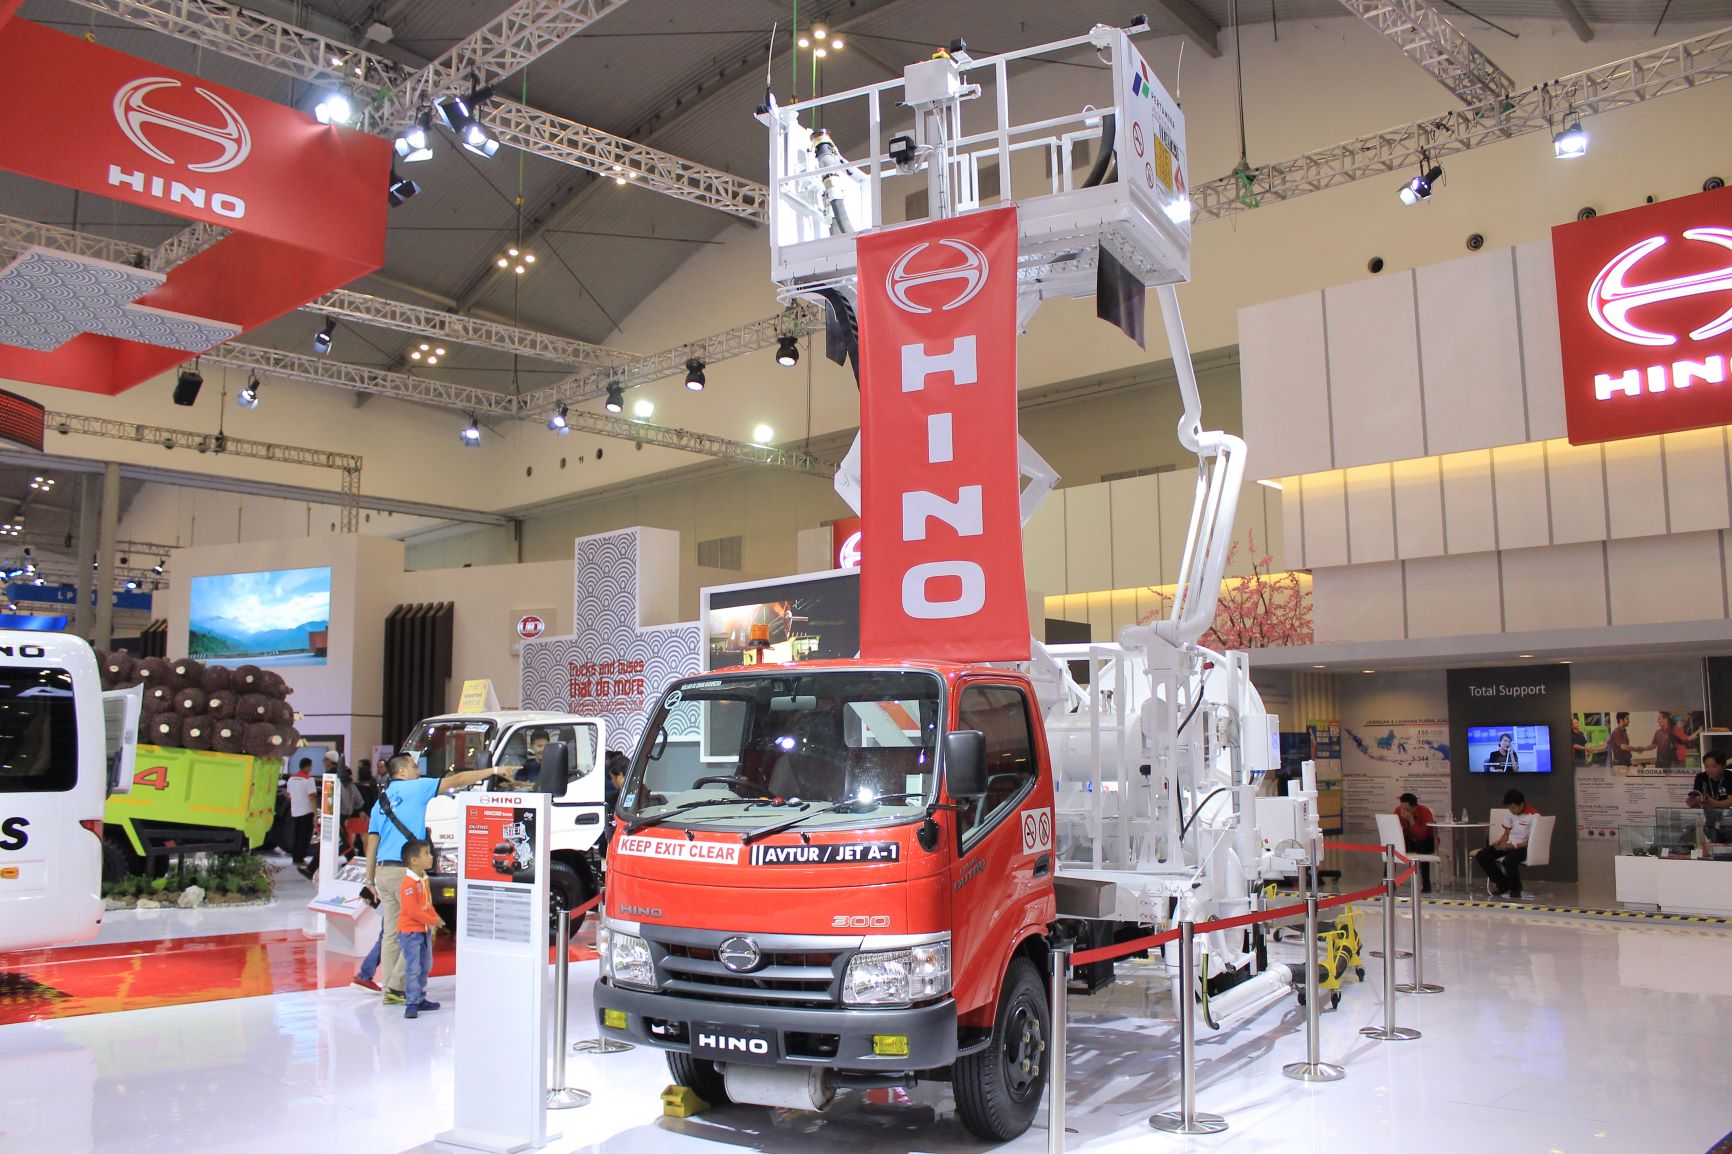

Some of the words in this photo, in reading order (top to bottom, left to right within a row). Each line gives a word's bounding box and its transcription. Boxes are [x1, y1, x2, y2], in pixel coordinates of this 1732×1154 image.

[107, 163, 246, 219] HINO
[1593, 354, 1732, 401] HIN
[901, 334, 986, 619] HINO
[568, 661, 597, 677] Trucks
[598, 657, 615, 676] and
[618, 658, 645, 675] buses
[569, 677, 593, 698] that
[595, 676, 610, 697] do
[613, 678, 645, 696] more
[1469, 685, 1496, 697] Total
[1499, 684, 1547, 698] Support
[491, 796, 522, 805] HINO
[0, 816, 31, 851] S
[620, 838, 652, 853] KEEP
[655, 841, 686, 857] EXIT
[689, 844, 736, 860] CLEAR
[765, 847, 819, 863] AVTUR
[823, 846, 832, 863] /
[835, 845, 864, 861] JET
[867, 844, 897, 860] A-1
[619, 903, 664, 918] HINO
[831, 915, 891, 928] 300
[698, 1033, 769, 1054] HINO
